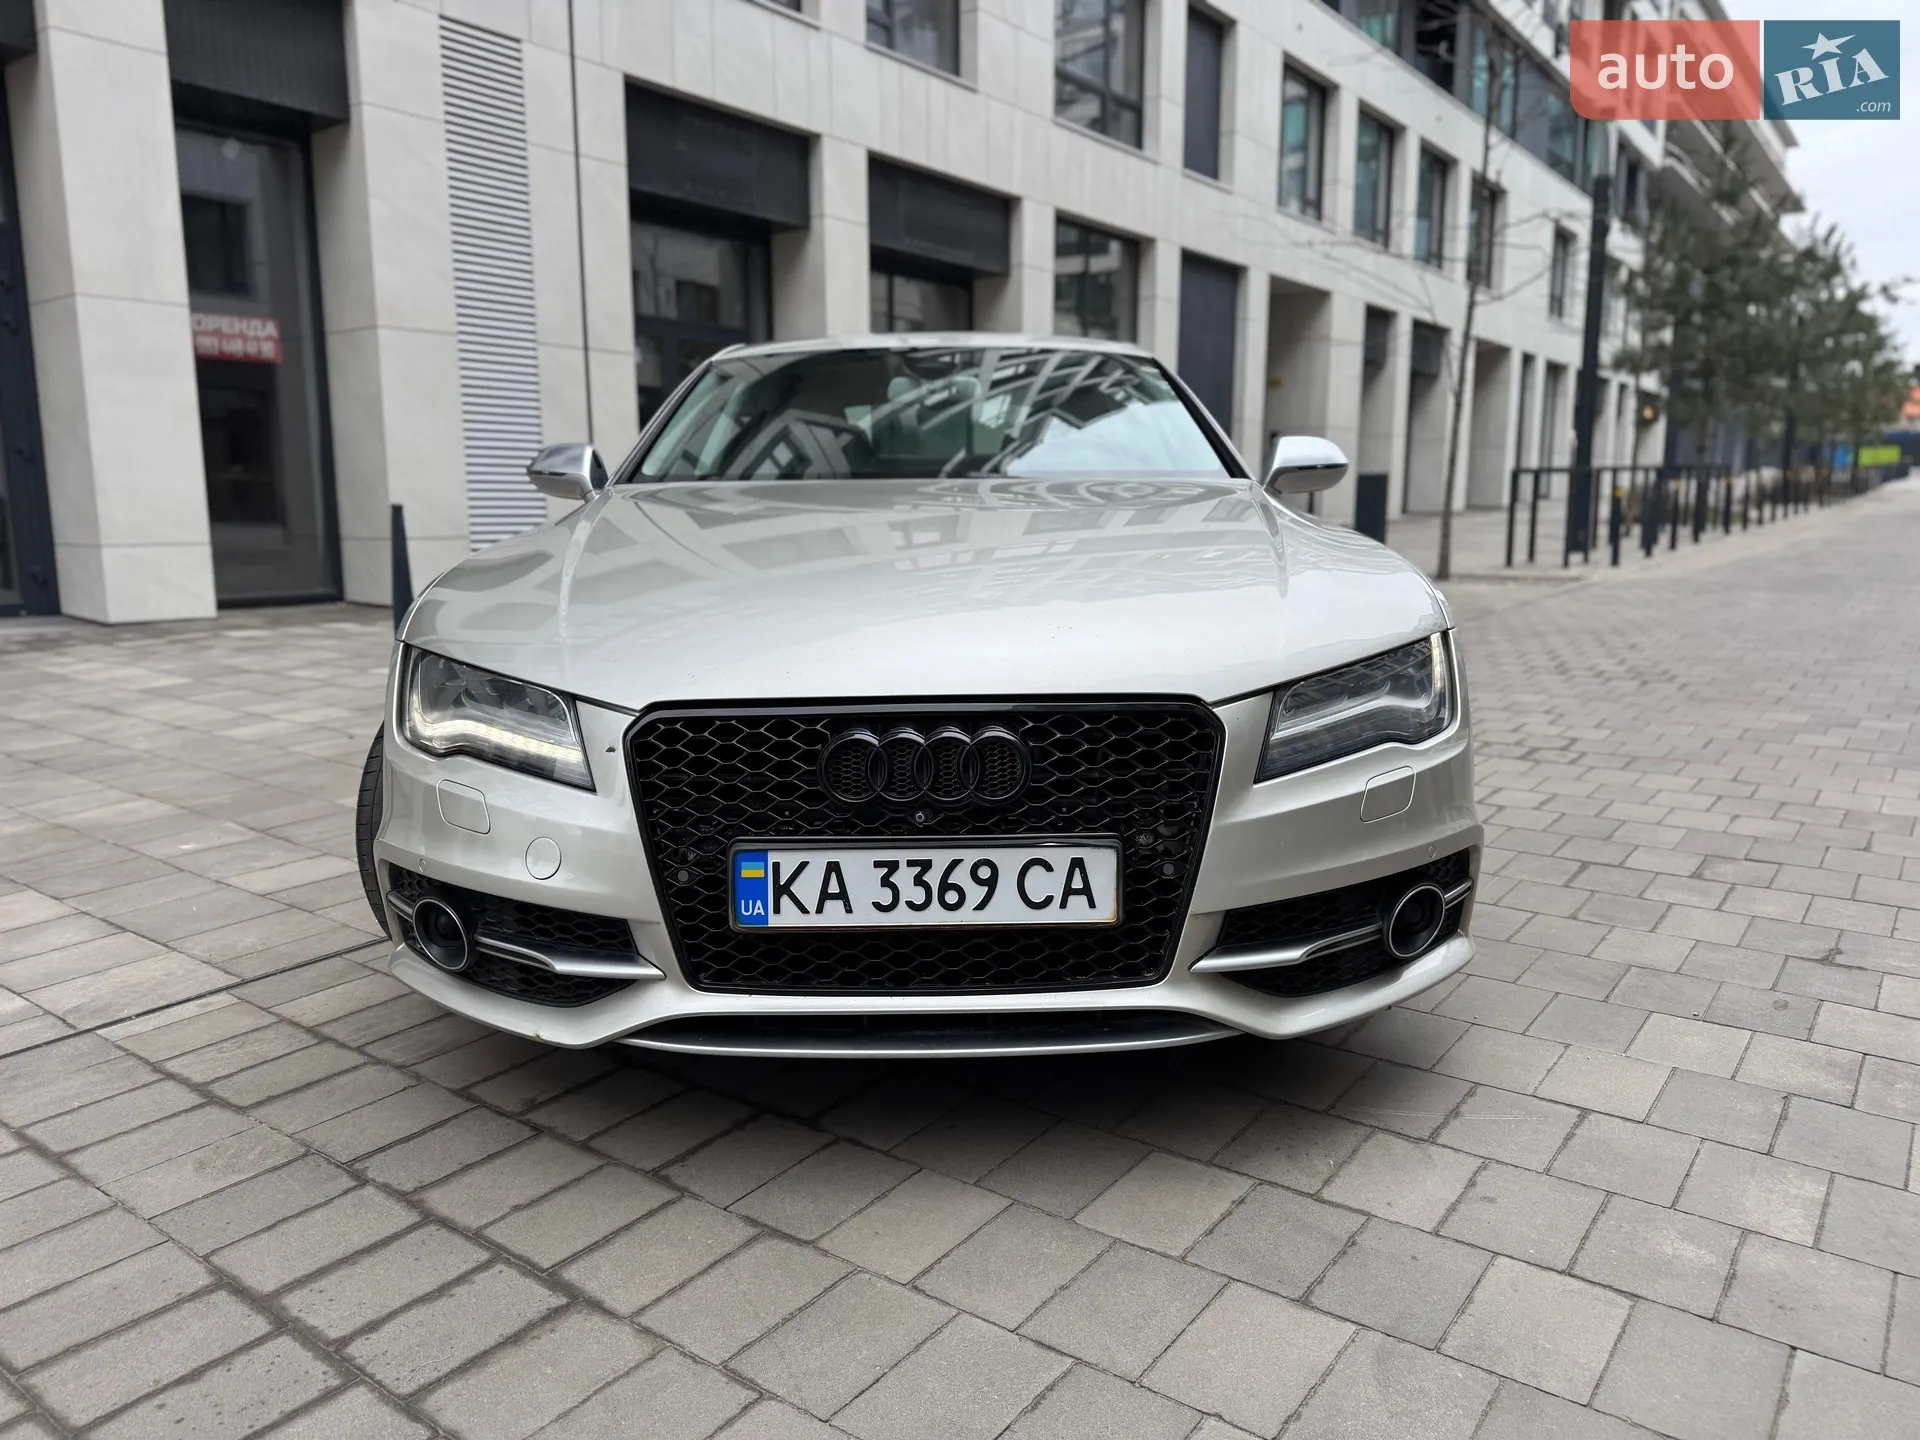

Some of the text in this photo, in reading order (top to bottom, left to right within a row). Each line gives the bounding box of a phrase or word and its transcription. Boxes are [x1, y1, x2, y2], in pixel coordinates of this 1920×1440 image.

[772, 856, 1096, 914] KA 3369 CA
[741, 900, 765, 916] UA
